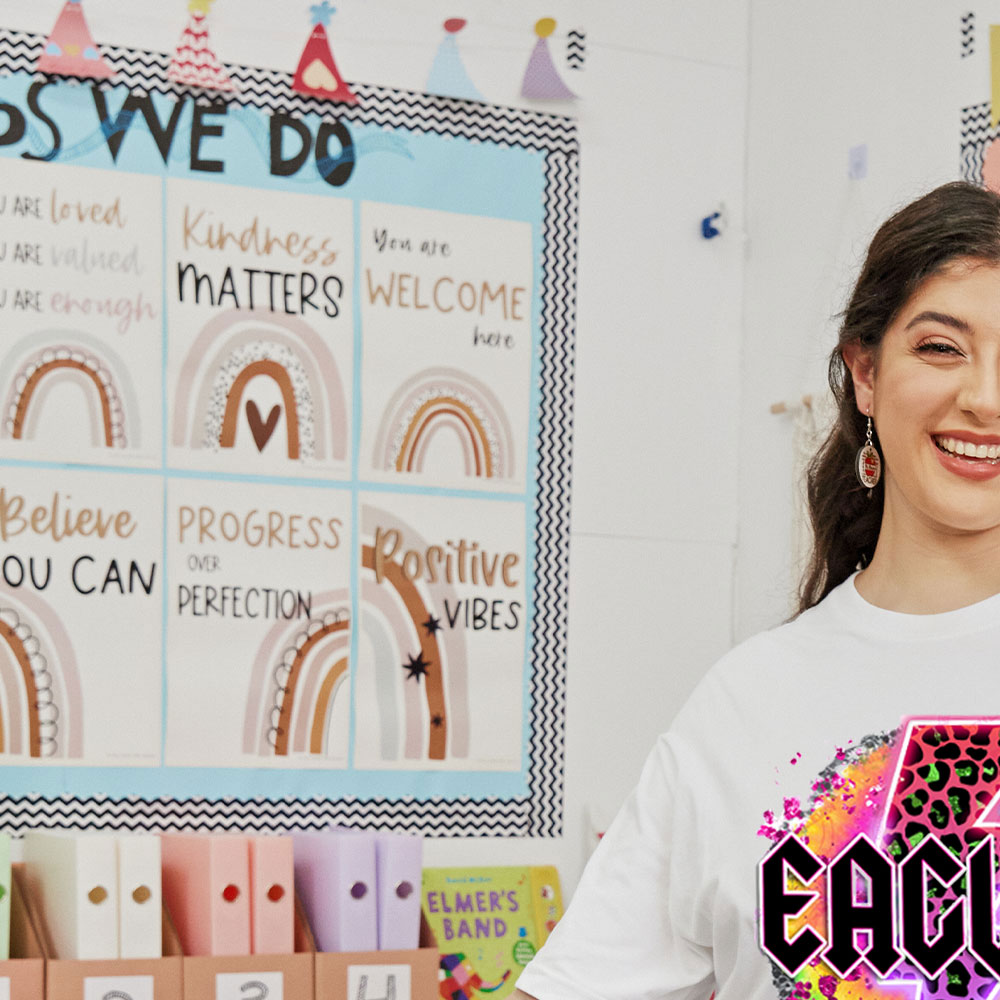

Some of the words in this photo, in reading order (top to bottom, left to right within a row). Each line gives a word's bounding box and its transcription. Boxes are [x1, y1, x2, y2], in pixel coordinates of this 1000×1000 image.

[90, 86, 228, 172] WE
[269, 111, 356, 187] DO
[13, 195, 43, 219] ARE
[50, 187, 126, 229] loved
[182, 204, 339, 268] Kindness
[373, 227, 413, 258] You
[419, 239, 452, 258] are
[13, 242, 43, 265] ARE
[51, 239, 144, 276] valued
[13, 288, 43, 312] ARE
[51, 290, 158, 335] enough
[366, 268, 526, 321] WELCOME
[472, 325, 516, 351] here
[0, 487, 137, 542] Believe
[178, 506, 343, 550] PROGRESS
[2, 555, 52, 591] OU
[72, 555, 156, 595] CAN
[188, 554, 221, 572] OVER
[374, 526, 521, 588] Positive
[177, 584, 313, 620] PERFECTION
[444, 597, 521, 631] VIBES
[427, 889, 519, 914] ELMER'S
[443, 918, 507, 940] BAND
